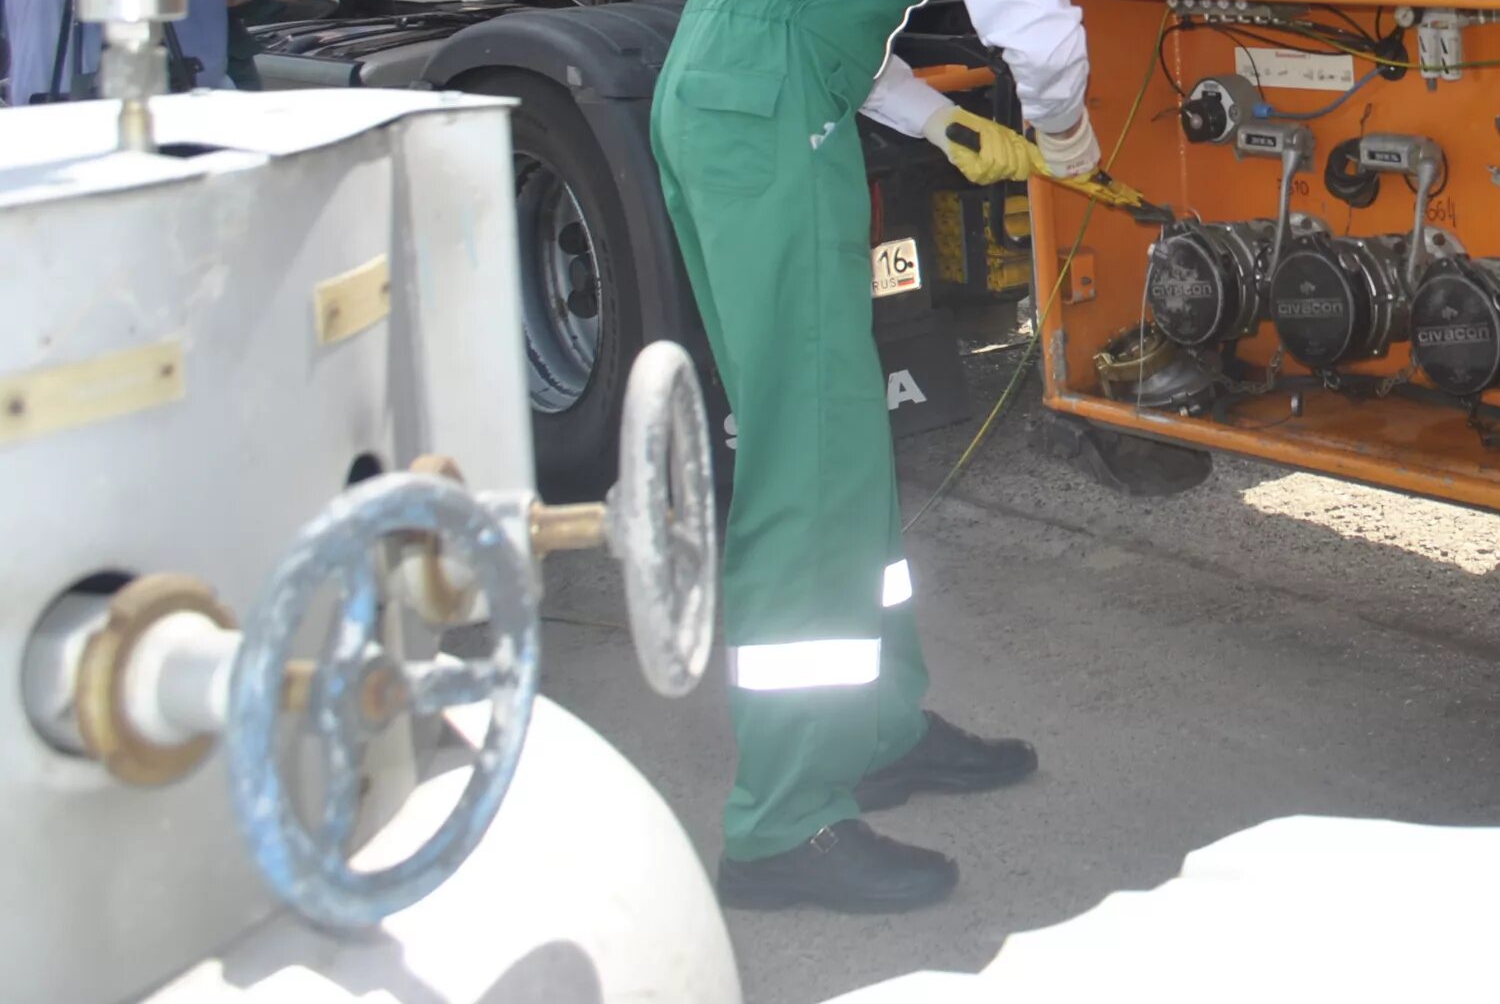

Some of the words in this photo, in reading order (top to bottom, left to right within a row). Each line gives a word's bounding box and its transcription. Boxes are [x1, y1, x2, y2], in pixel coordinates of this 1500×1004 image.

[879, 248, 908, 276] 16
[872, 277, 897, 293] RUS
[1278, 300, 1343, 315] civacon
[1418, 325, 1490, 343] civacon
